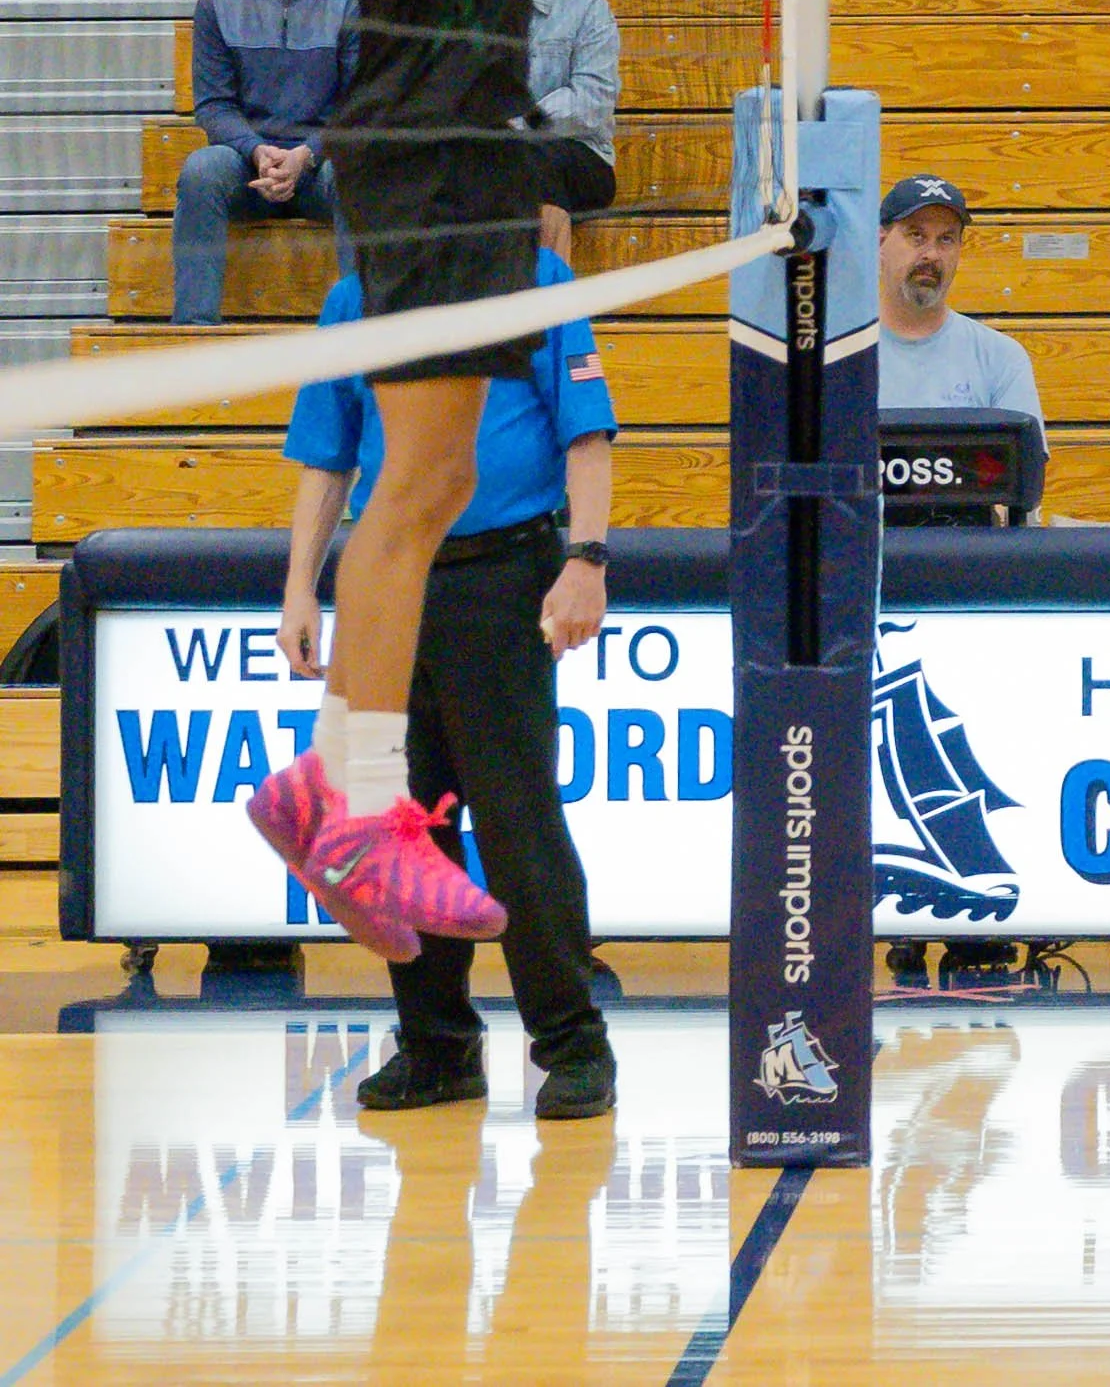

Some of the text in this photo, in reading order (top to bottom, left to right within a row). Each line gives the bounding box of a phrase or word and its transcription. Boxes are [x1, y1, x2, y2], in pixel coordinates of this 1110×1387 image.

[779, 724, 817, 984] sports imports
[747, 1131, 780, 1145] (800)
